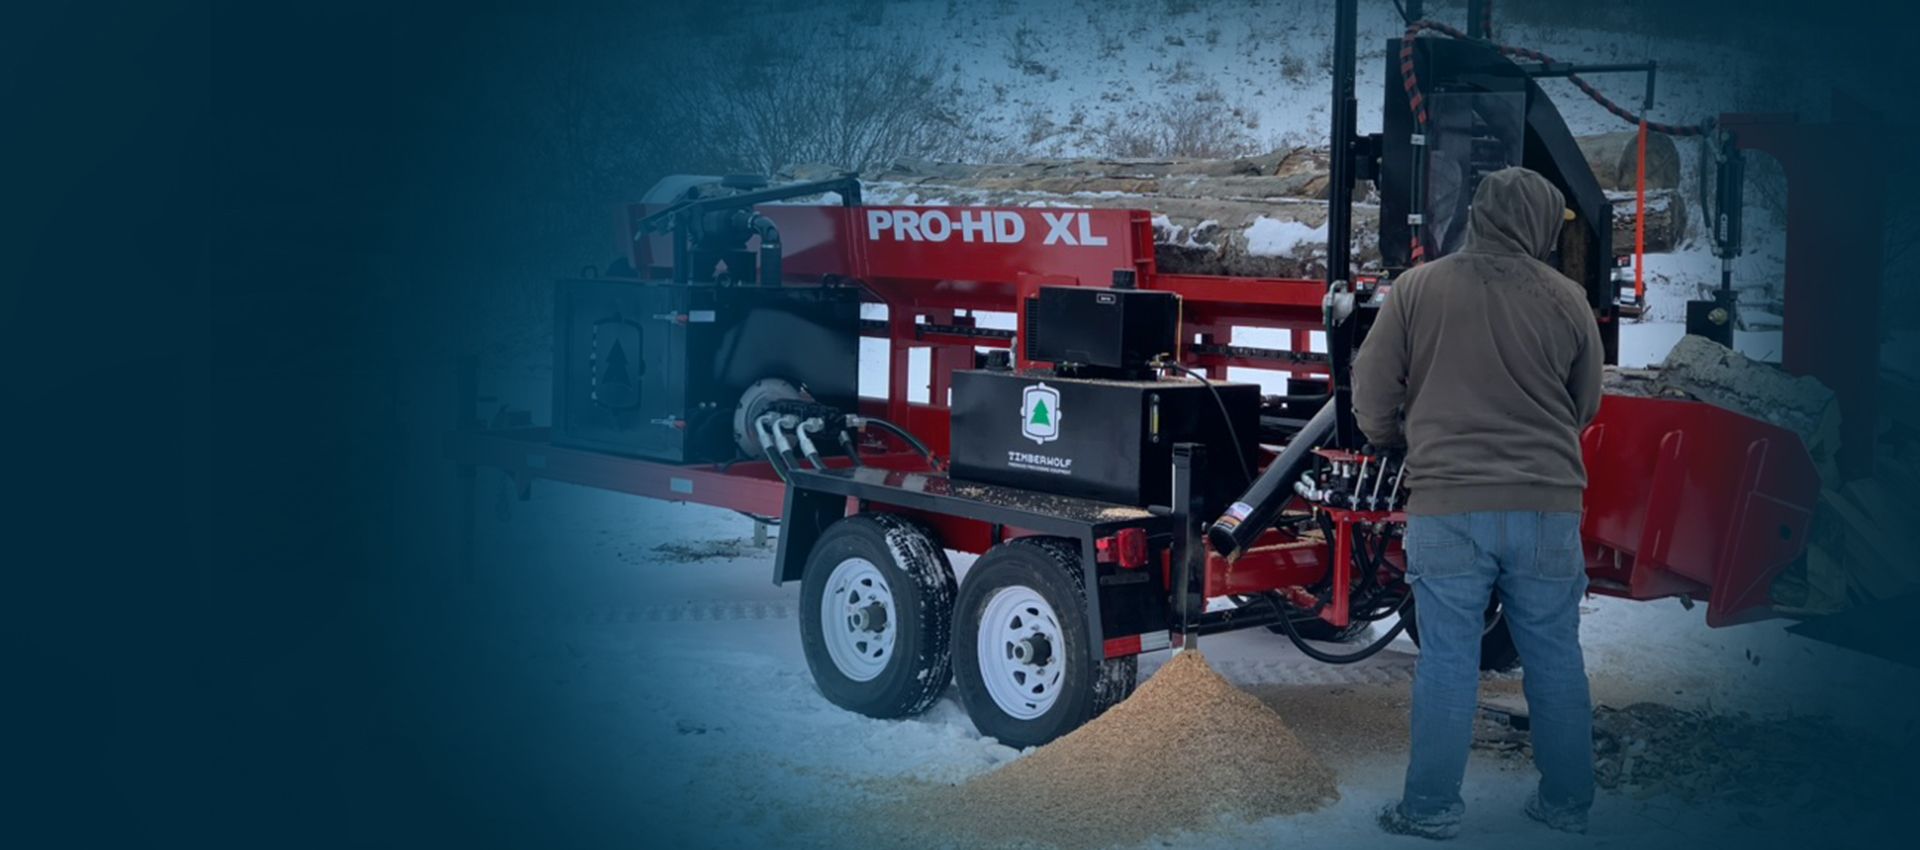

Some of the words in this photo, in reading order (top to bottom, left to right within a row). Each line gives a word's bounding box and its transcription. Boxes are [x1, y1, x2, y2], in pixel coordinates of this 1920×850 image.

[867, 210, 1025, 243] PRO-HD
[1041, 212, 1108, 246] XL
[1008, 451, 1072, 468] TIMBERWOLF
